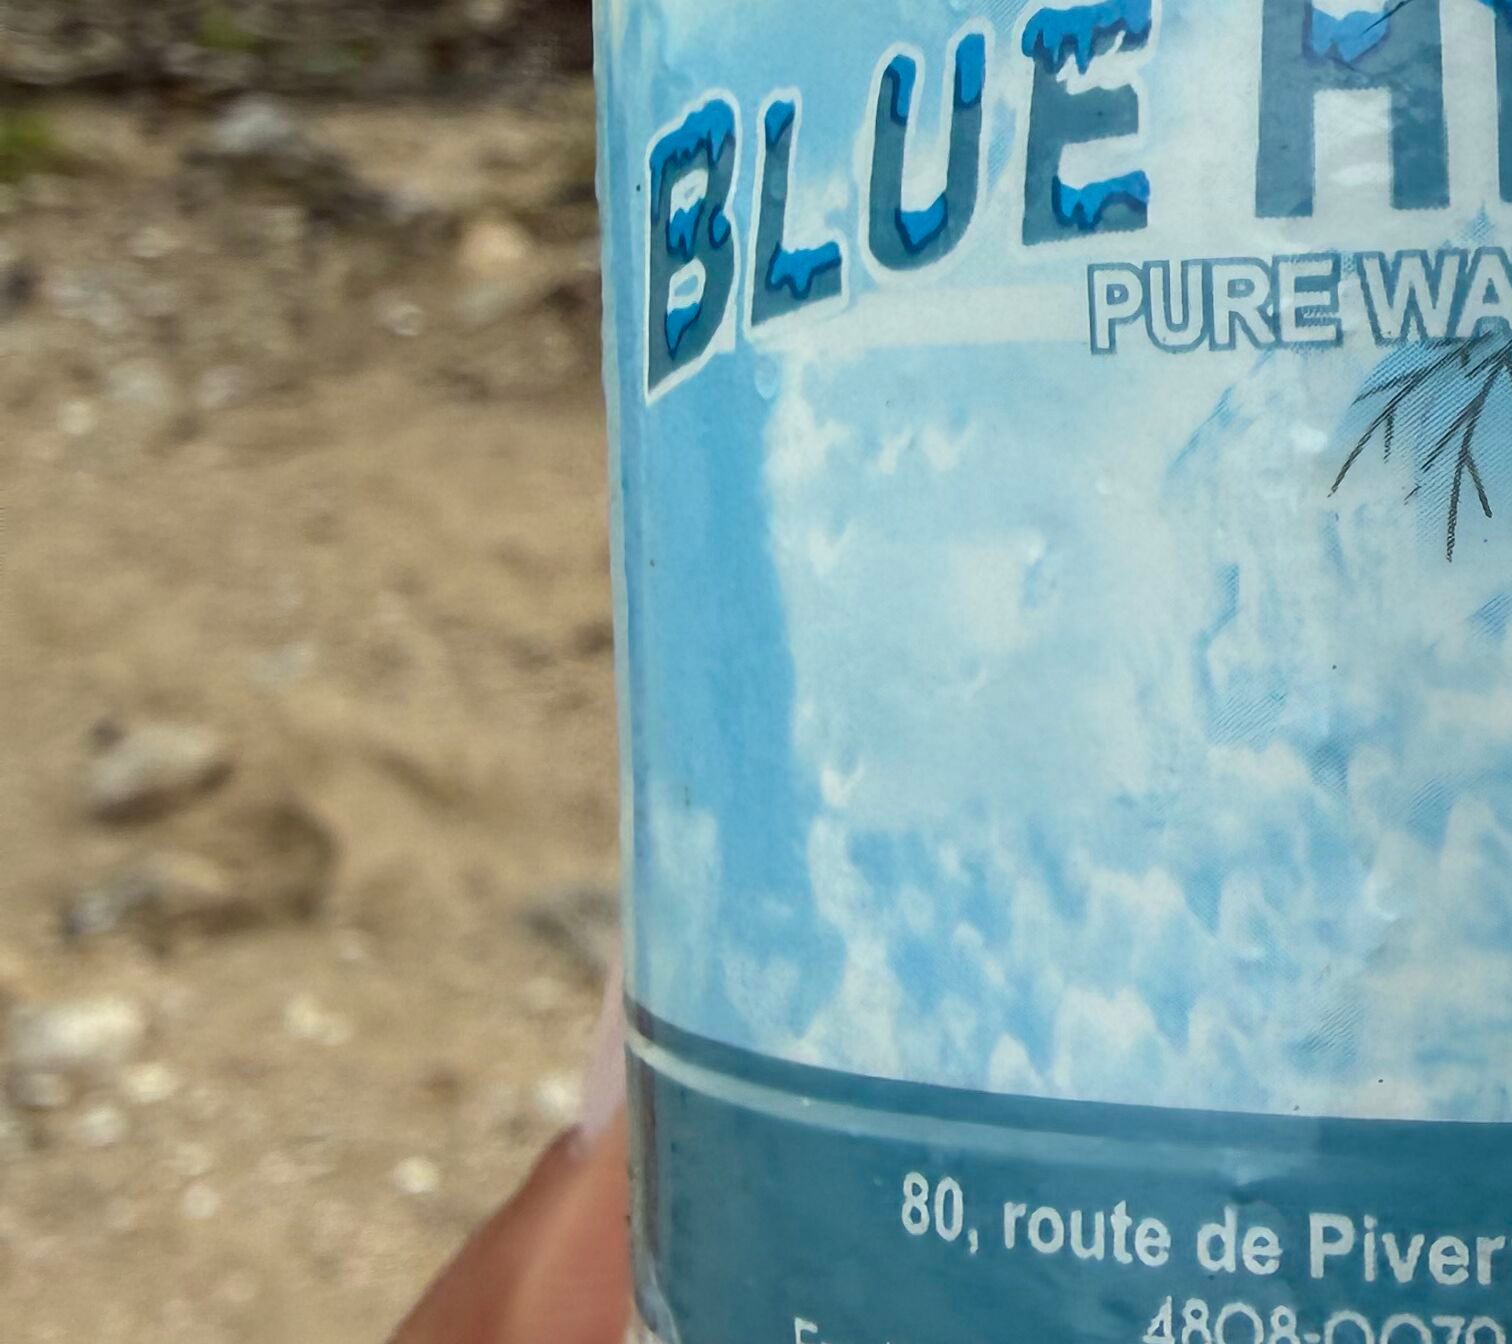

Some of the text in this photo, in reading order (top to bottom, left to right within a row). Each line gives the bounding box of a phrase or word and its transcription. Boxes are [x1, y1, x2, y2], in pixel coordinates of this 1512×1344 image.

[1087, 252, 1343, 355] PURE
[900, 1171, 981, 1254] 80,
[1002, 1199, 1171, 1268] route
[1197, 1204, 1282, 1276] de
